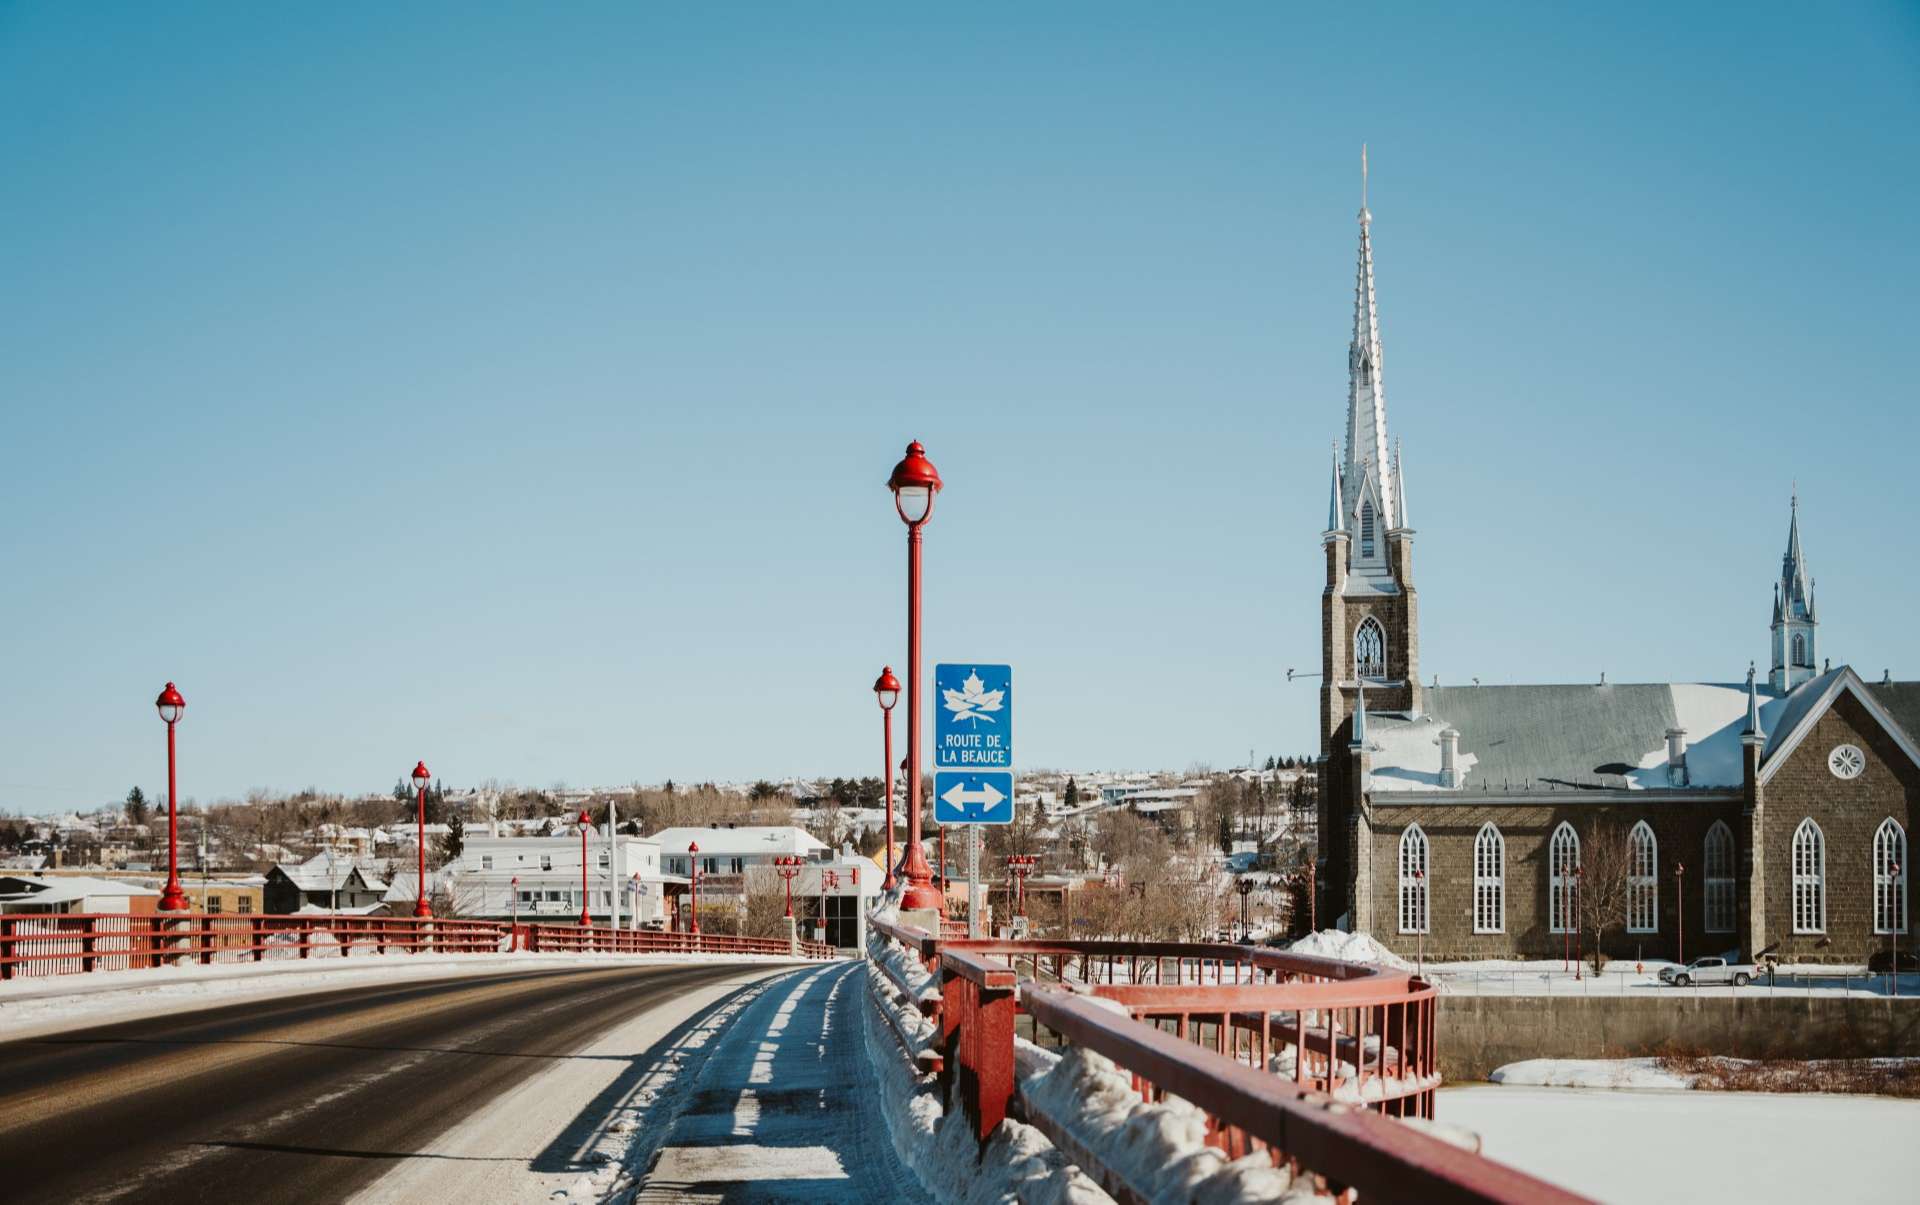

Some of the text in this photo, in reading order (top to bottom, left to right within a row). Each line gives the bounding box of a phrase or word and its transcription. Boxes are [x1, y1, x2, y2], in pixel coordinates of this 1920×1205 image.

[945, 734, 1001, 747] ROUTE DE
[942, 750, 1005, 763] LA BEAUCE
